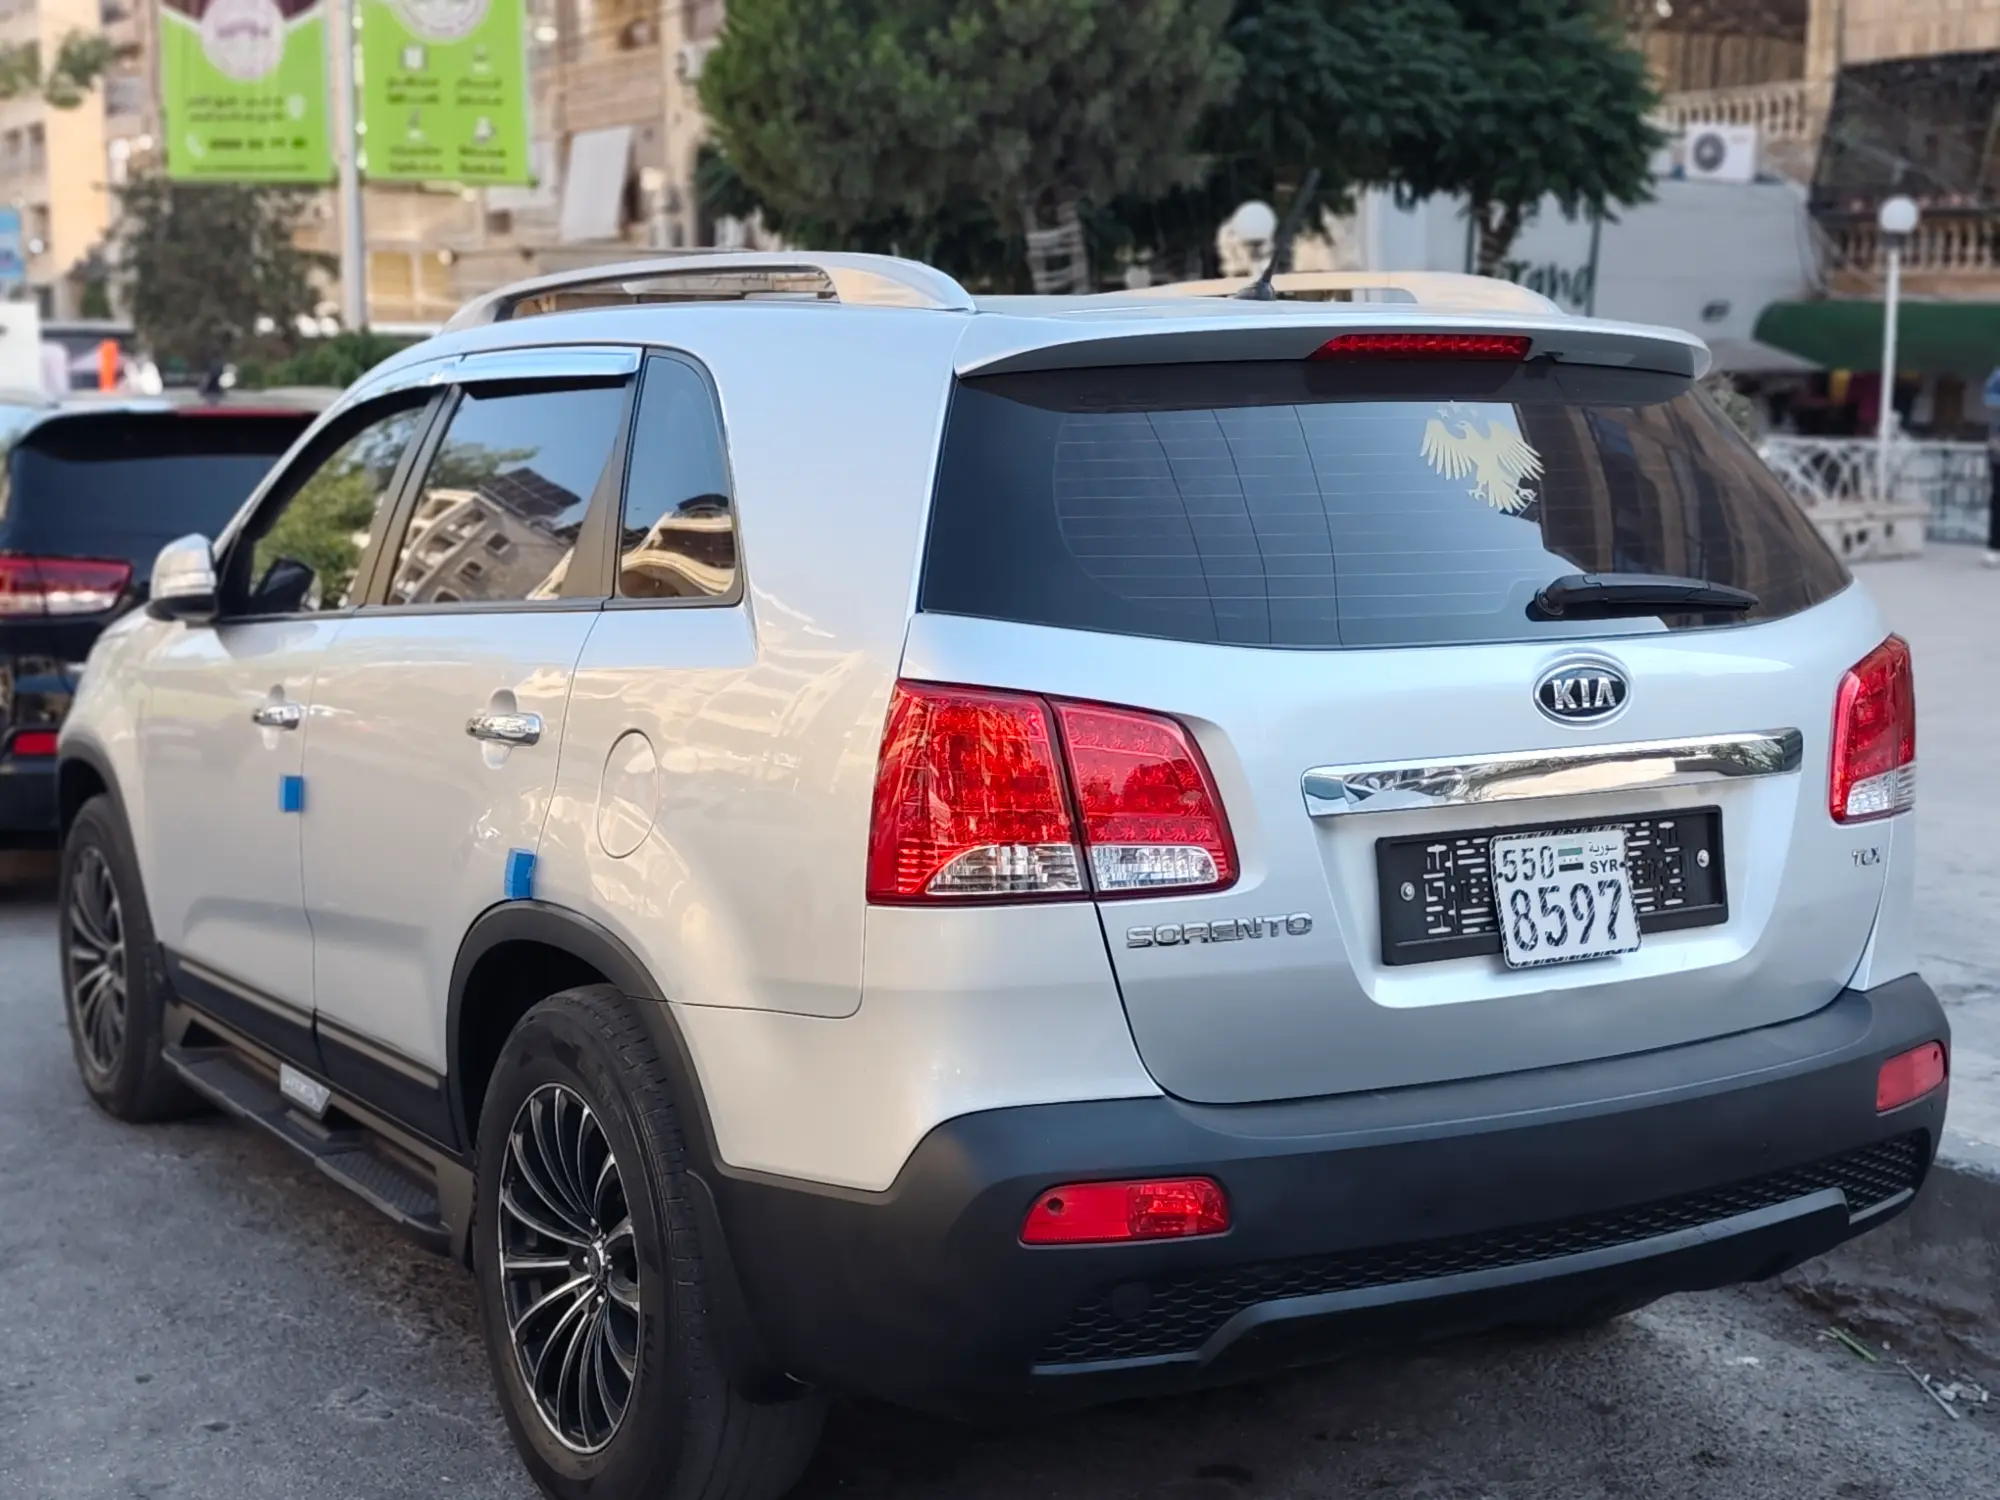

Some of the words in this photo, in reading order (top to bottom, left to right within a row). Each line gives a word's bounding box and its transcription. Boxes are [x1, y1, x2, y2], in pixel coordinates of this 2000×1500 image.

[1552, 677, 1616, 710] KIA
[1502, 845, 1555, 883] 550
[1588, 841, 1618, 857] سورية
[1589, 858, 1619, 875] SYR
[1126, 911, 1314, 949] SORENTO
[1510, 879, 1622, 951] 8597
